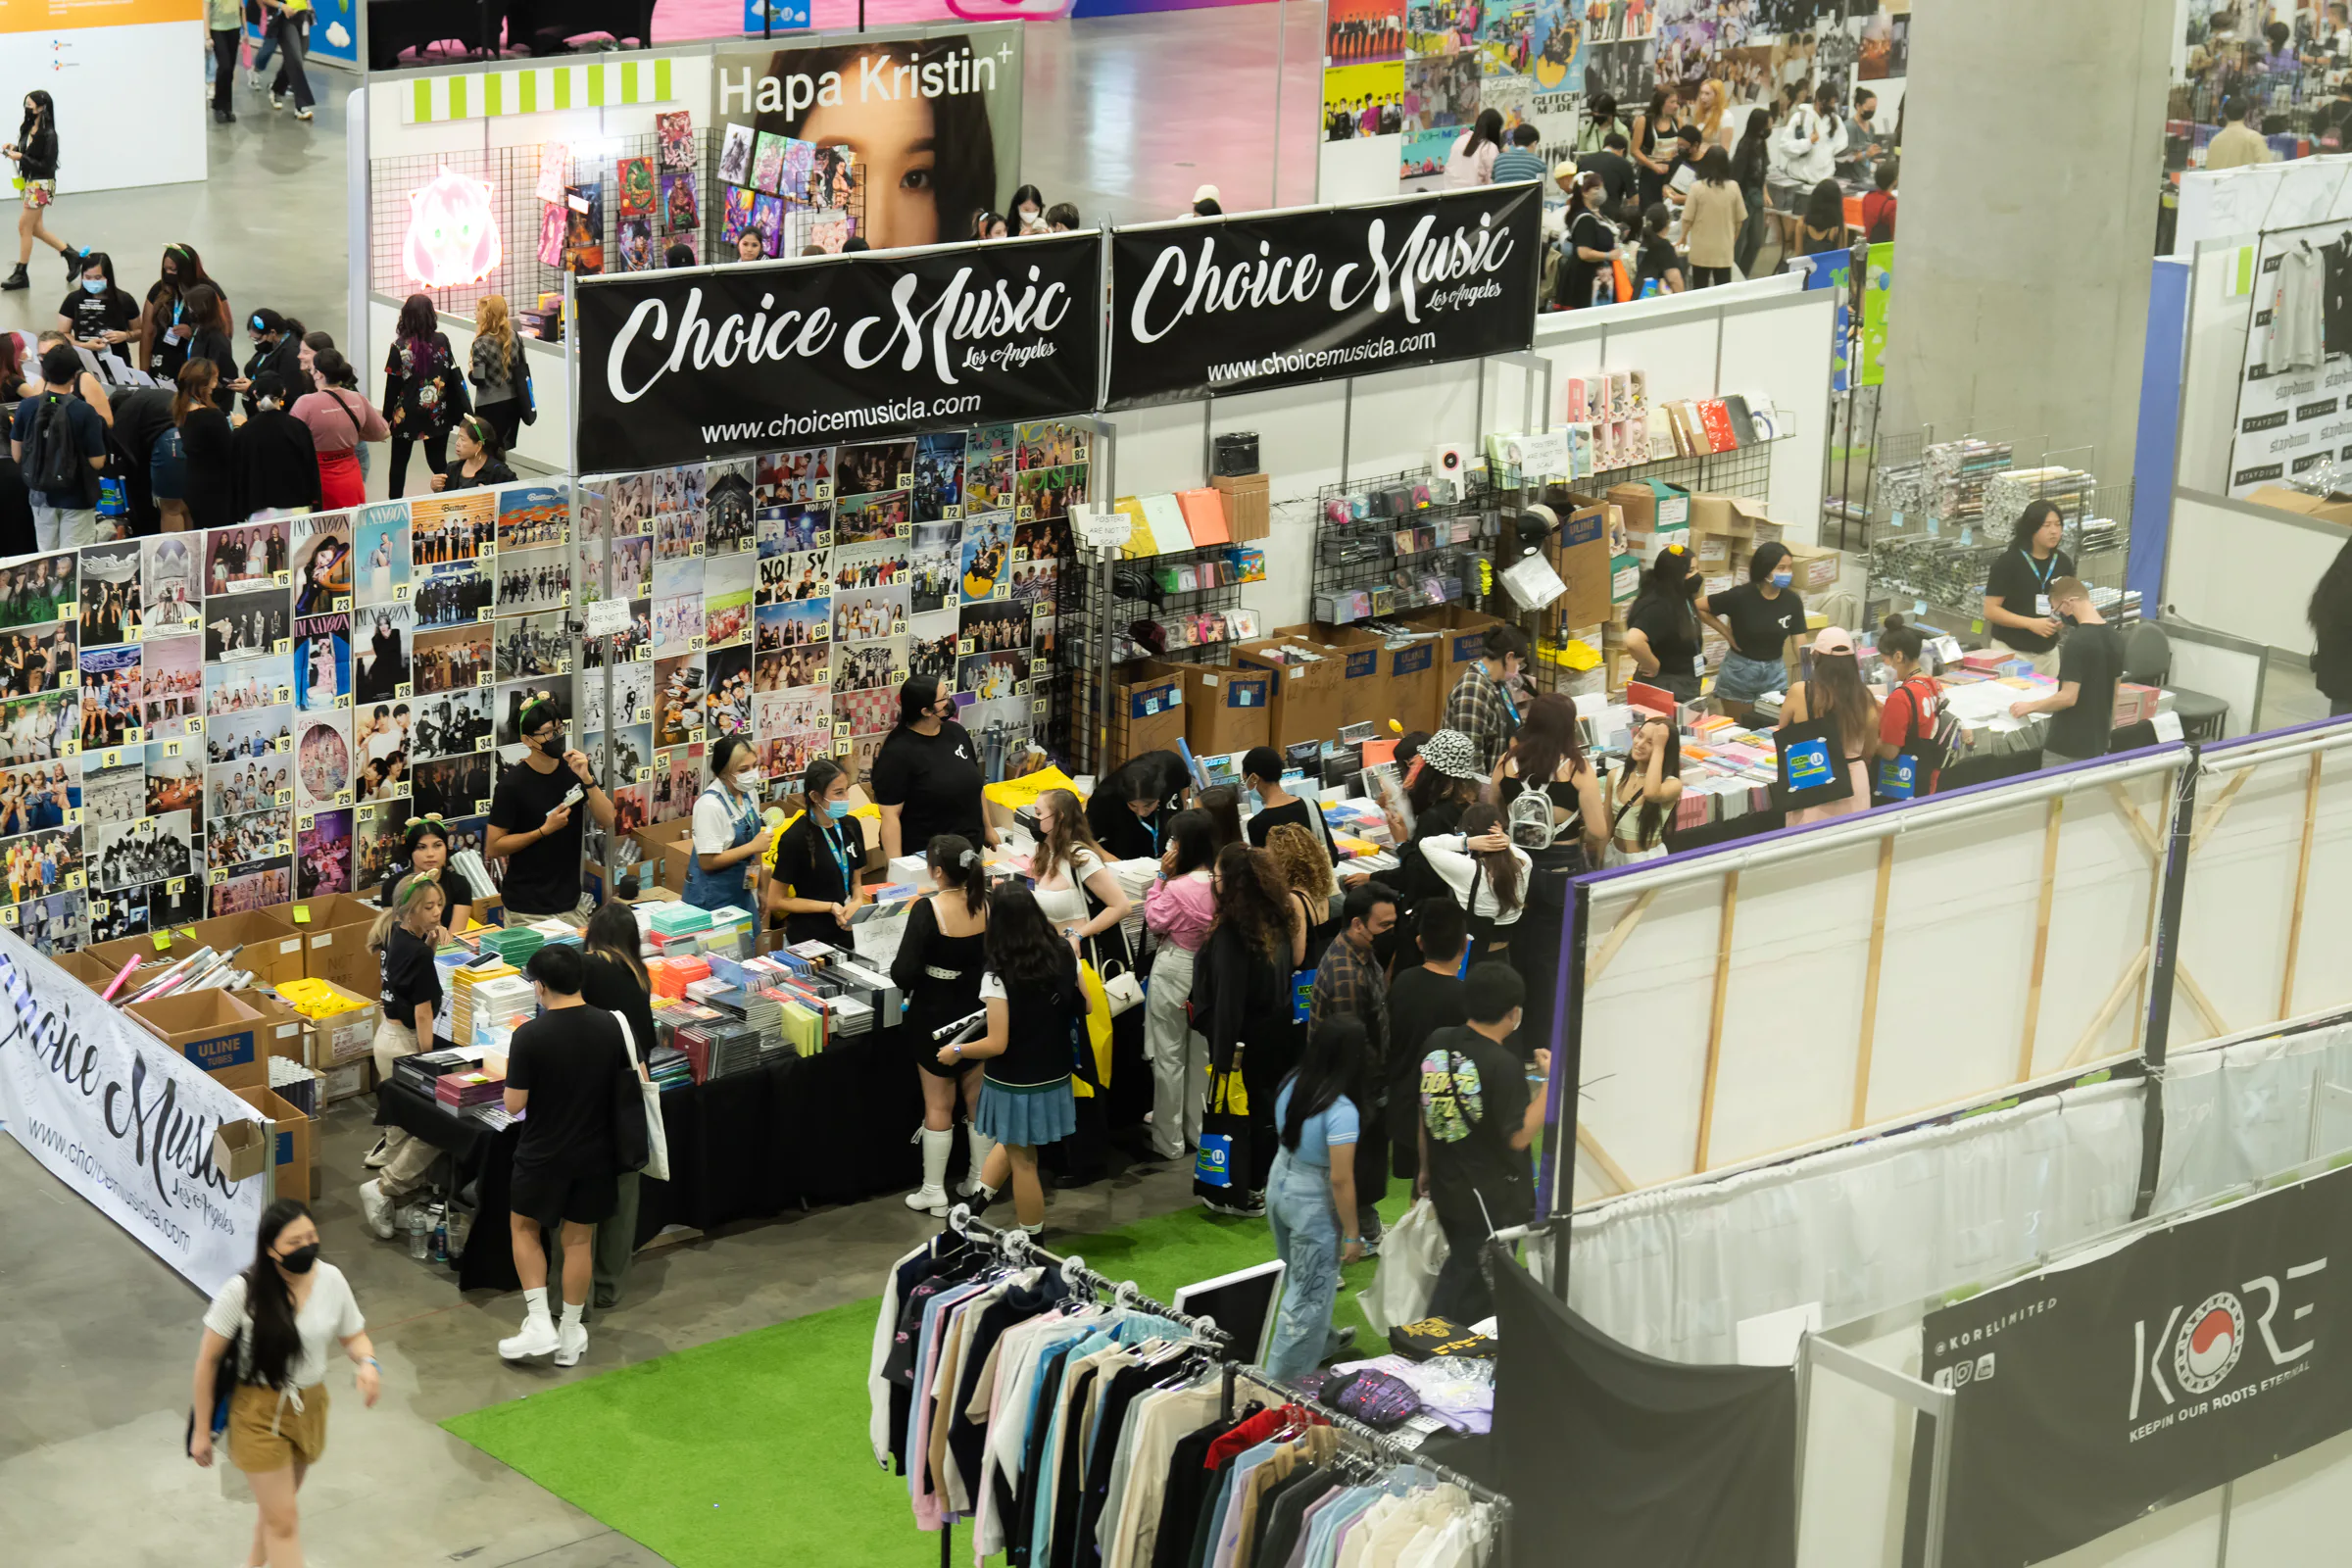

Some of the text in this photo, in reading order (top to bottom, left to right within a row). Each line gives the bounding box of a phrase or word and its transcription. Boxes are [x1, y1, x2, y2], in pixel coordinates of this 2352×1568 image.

[719, 66, 843, 122] Hapa
[1532, 92, 1580, 107] GLITCH
[1131, 212, 1515, 344] Choice Music
[1425, 277, 1502, 311] Los Angeles
[607, 265, 1071, 404] Choice Music
[961, 337, 1057, 371] Los Angeles
[1207, 330, 1437, 382] www.choicemusicla.com
[702, 392, 981, 444] www.choicemusicla.com
[2238, 466, 2282, 482] STAYDIUM
[1569, 519, 1595, 535] ULINE
[0, 953, 100, 1097] hoice
[198, 1038, 242, 1057] ULINE
[207, 1054, 233, 1066] TUBES
[2129, 1359, 2311, 1443] KEEPIN OUR ROOTS ETERNAL
